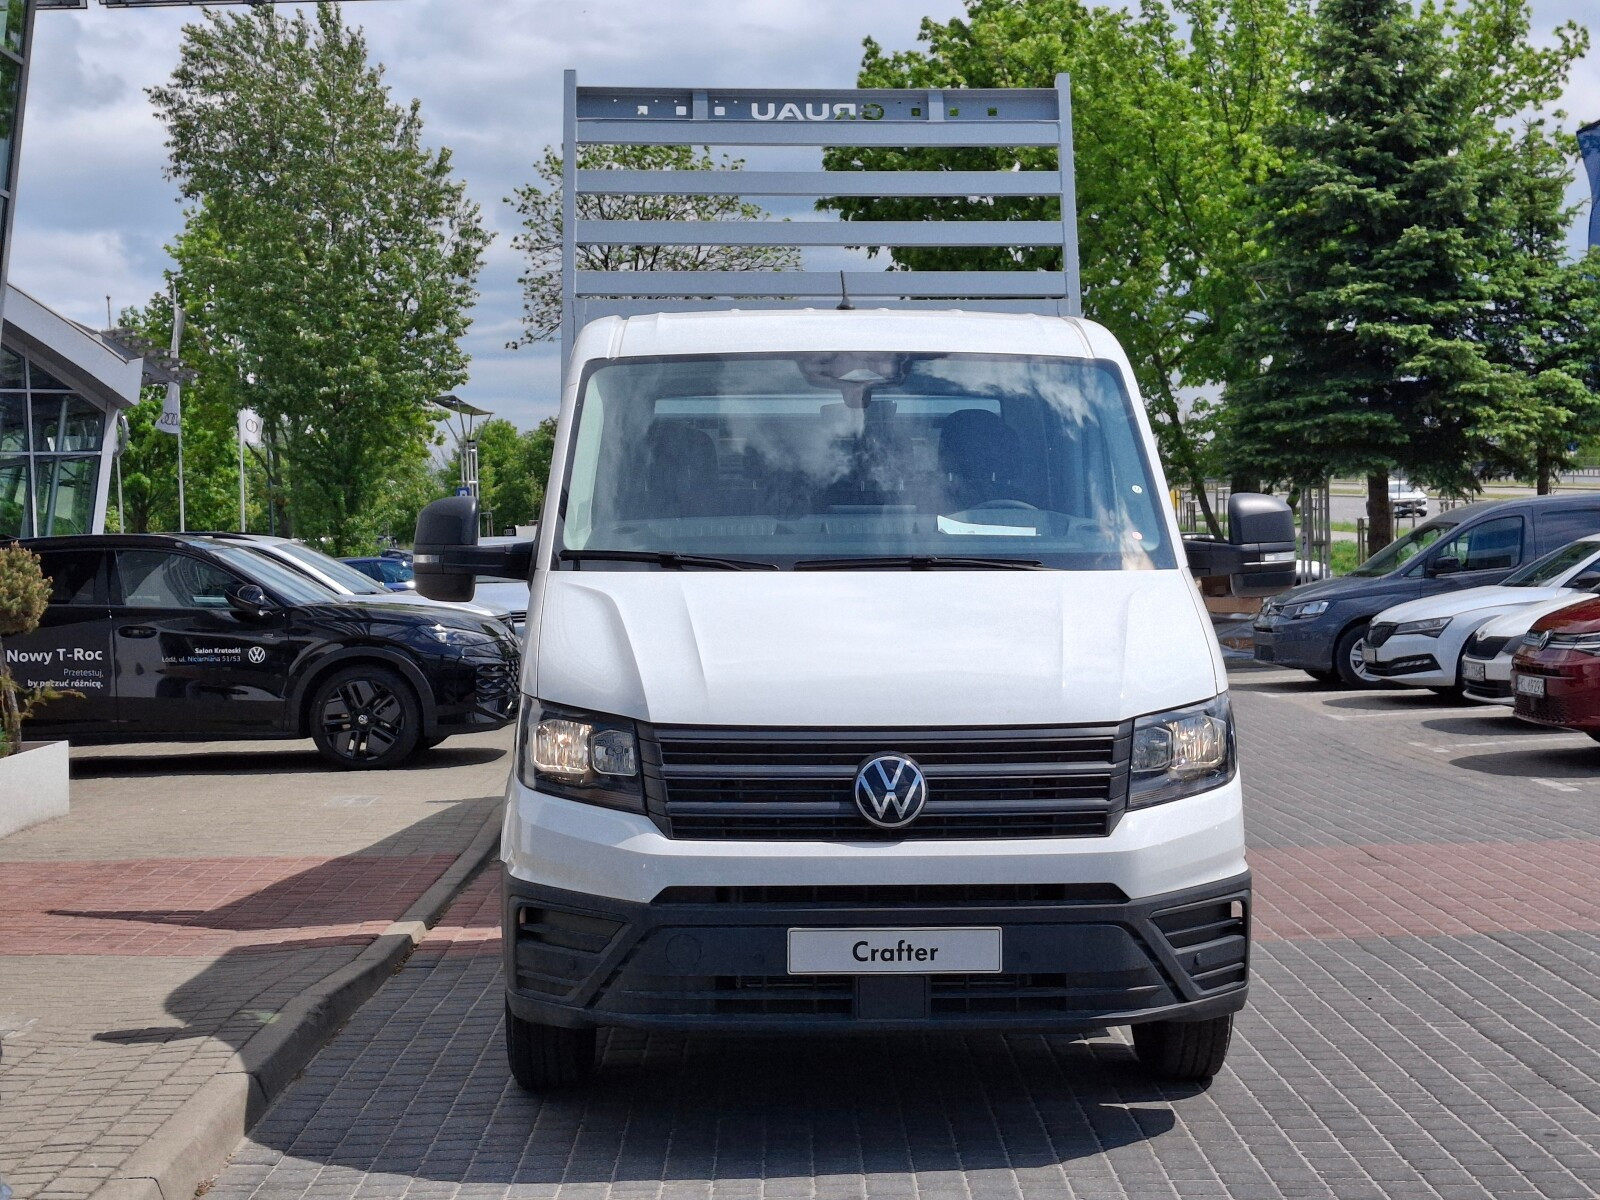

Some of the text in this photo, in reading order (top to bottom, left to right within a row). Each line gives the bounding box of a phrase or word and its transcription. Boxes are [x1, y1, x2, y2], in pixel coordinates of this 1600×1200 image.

[6, 647, 103, 665] Nowy T-Roc
[63, 668, 104, 679] Przetestuj,
[27, 679, 38, 689] by
[70, 679, 104, 689] różnicę.
[852, 939, 939, 962] Crafter
